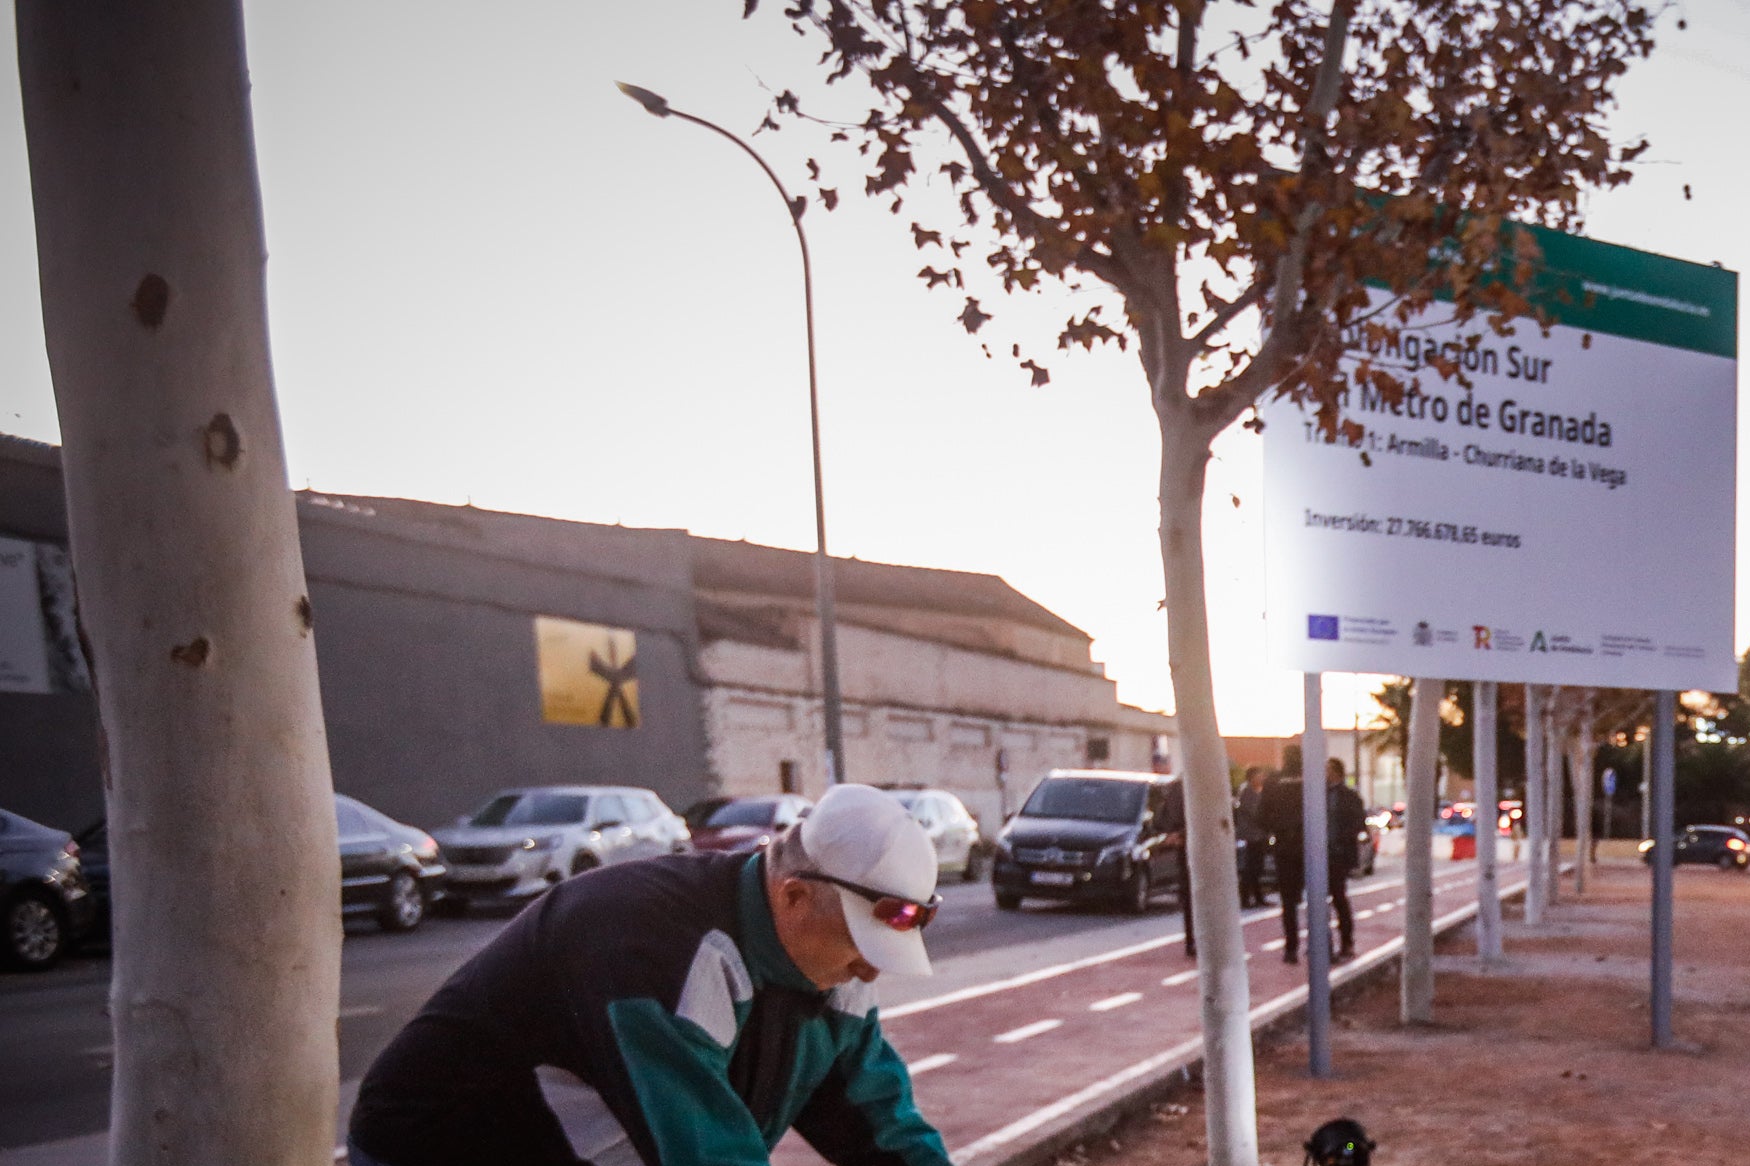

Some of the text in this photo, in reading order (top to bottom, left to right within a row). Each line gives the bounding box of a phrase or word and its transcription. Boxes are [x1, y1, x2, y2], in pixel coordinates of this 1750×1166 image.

[1507, 345, 1552, 383] Sur
[1457, 392, 1490, 429] de
[1499, 399, 1612, 447] Granada
[1388, 433, 1449, 460] Armilla
[1463, 443, 1545, 474] Churriana
[1549, 455, 1568, 477] de
[1571, 458, 1586, 479] la
[1589, 461, 1628, 490] Vega
[1304, 508, 1383, 534] Inversión:
